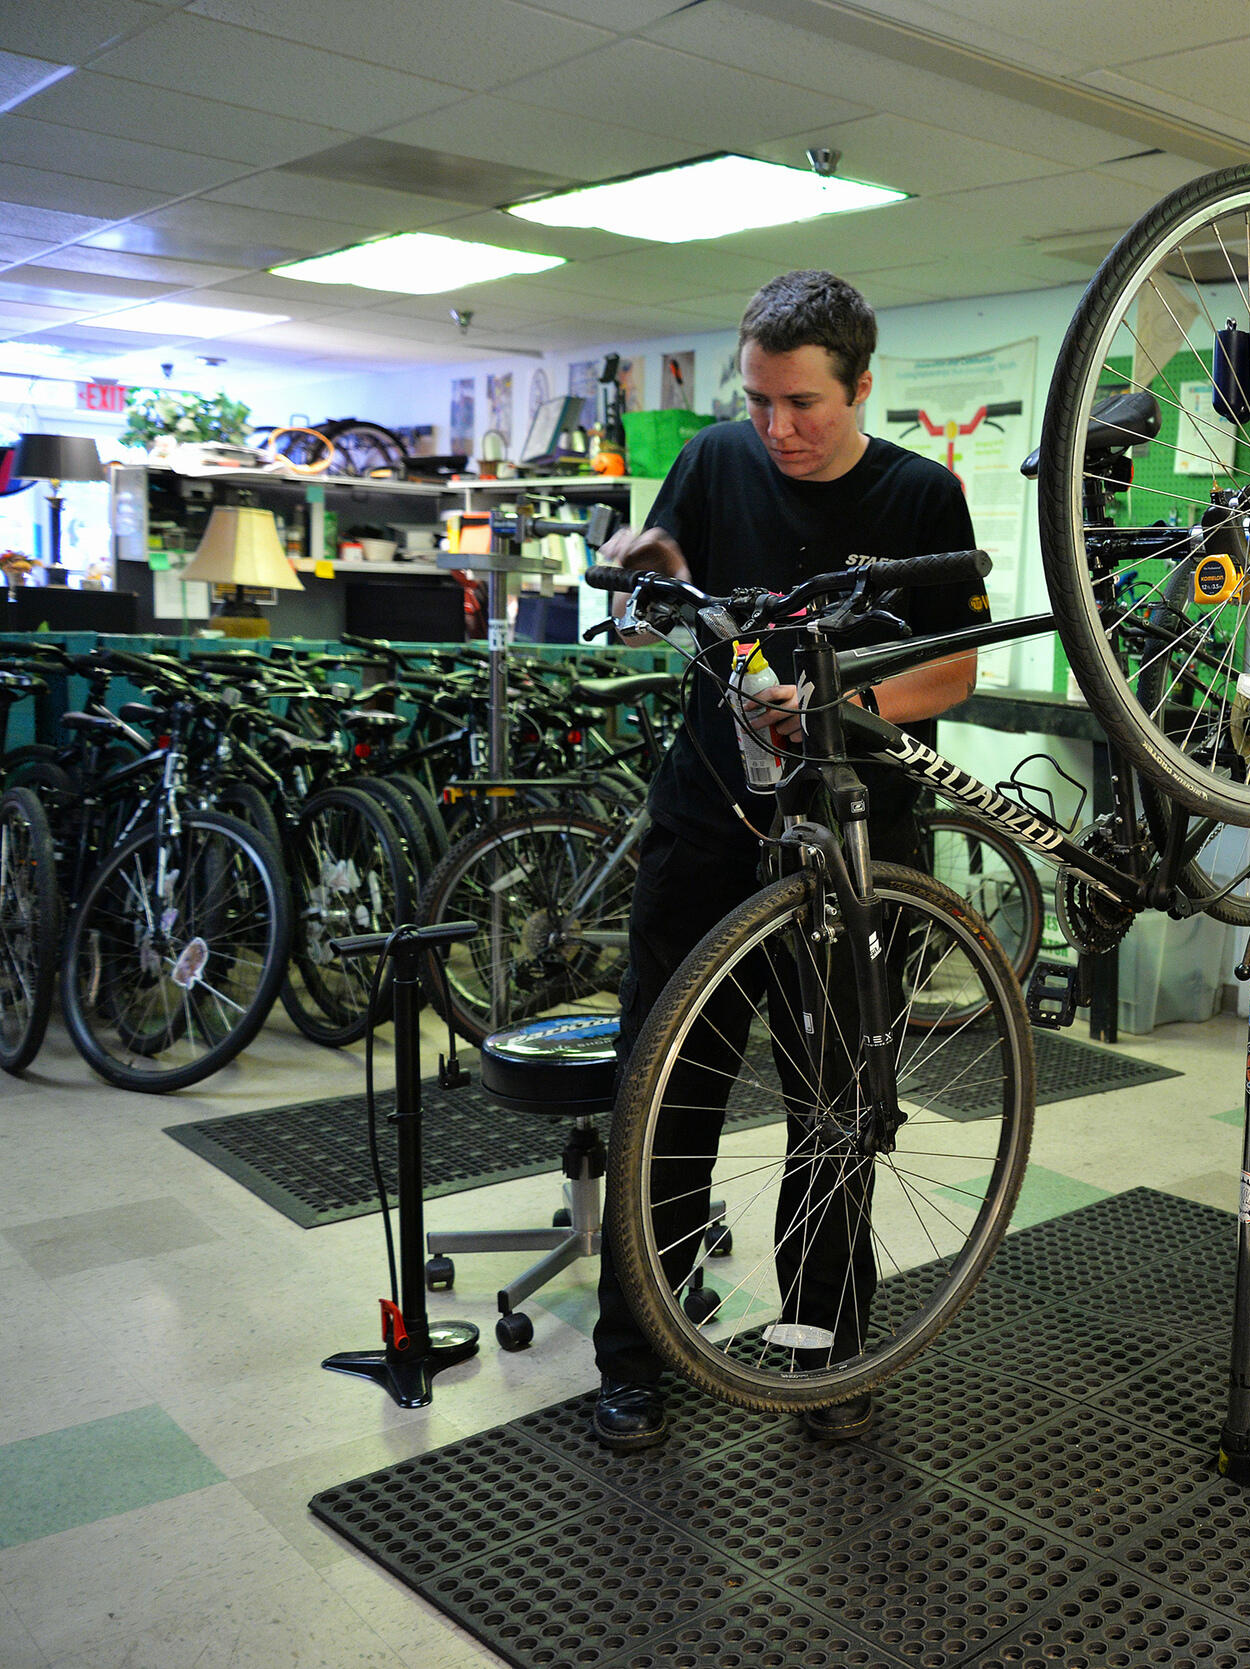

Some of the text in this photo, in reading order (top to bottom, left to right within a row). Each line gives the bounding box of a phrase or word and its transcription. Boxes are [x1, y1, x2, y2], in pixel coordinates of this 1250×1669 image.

[86, 383, 125, 411] EXIT
[845, 554, 896, 567] STAF
[885, 732, 1064, 850] SPECIALIZED
